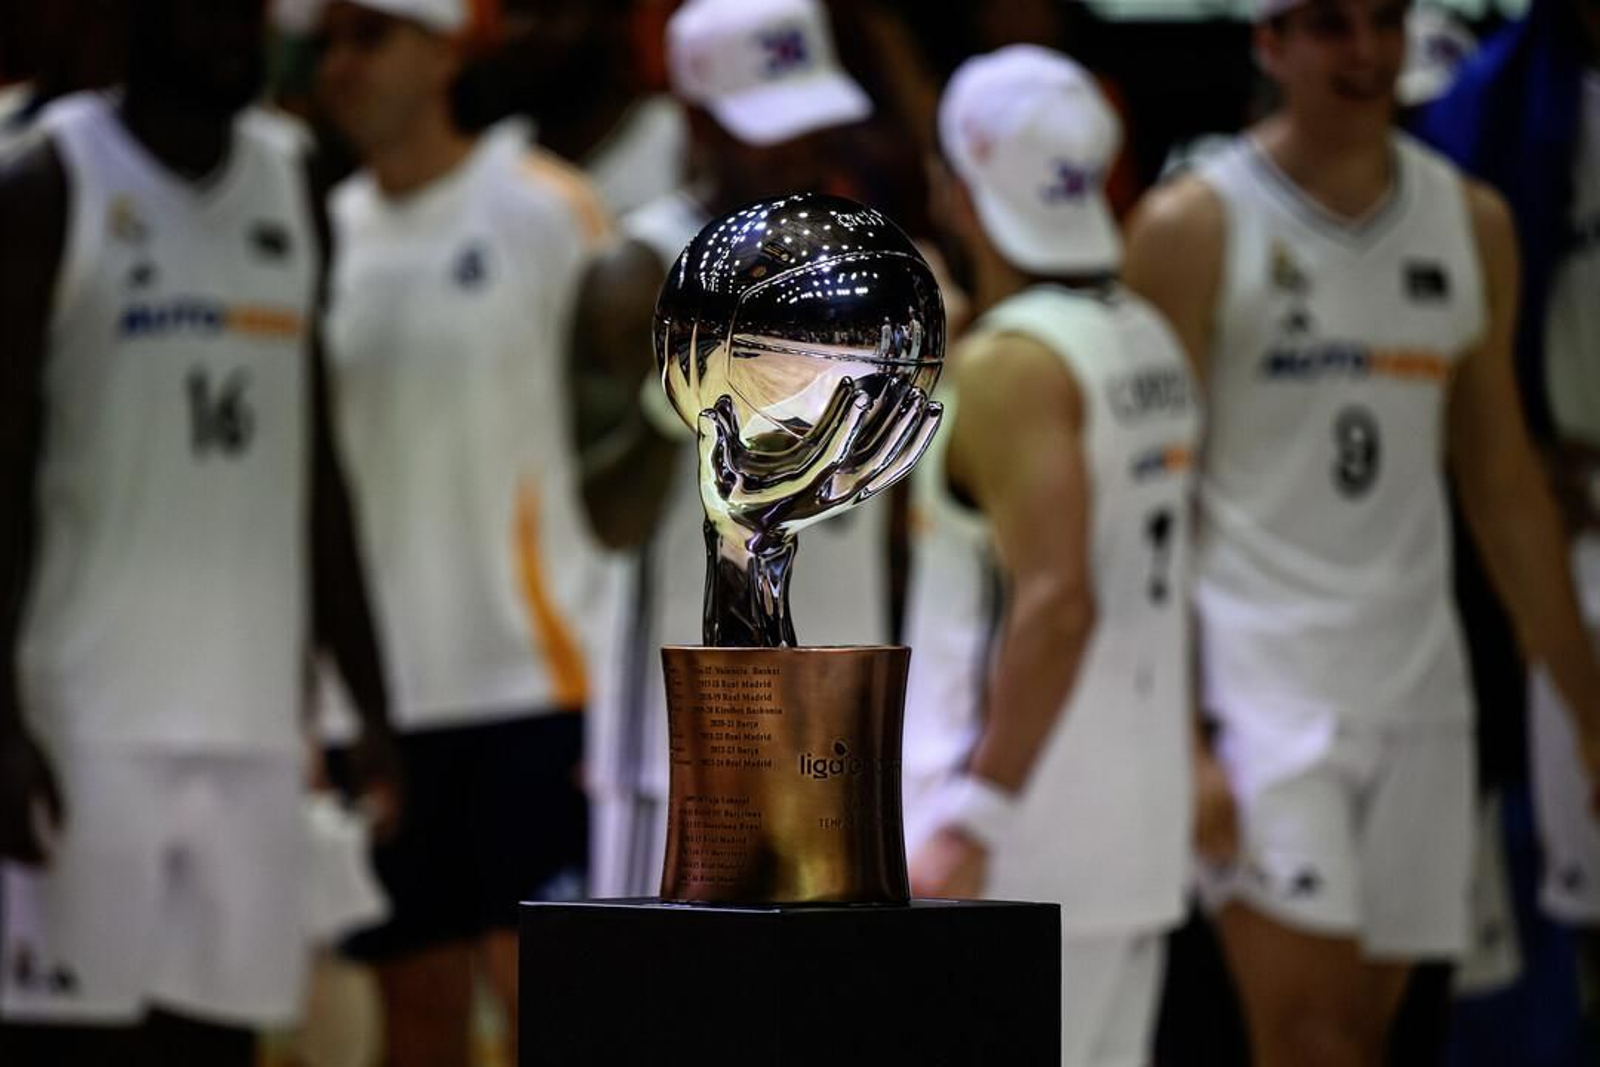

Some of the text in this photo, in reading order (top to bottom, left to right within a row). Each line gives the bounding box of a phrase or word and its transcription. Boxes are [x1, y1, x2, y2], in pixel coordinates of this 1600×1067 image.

[187, 368, 253, 460] 16
[1330, 406, 1382, 500] 9
[743, 693, 773, 701] Madrid
